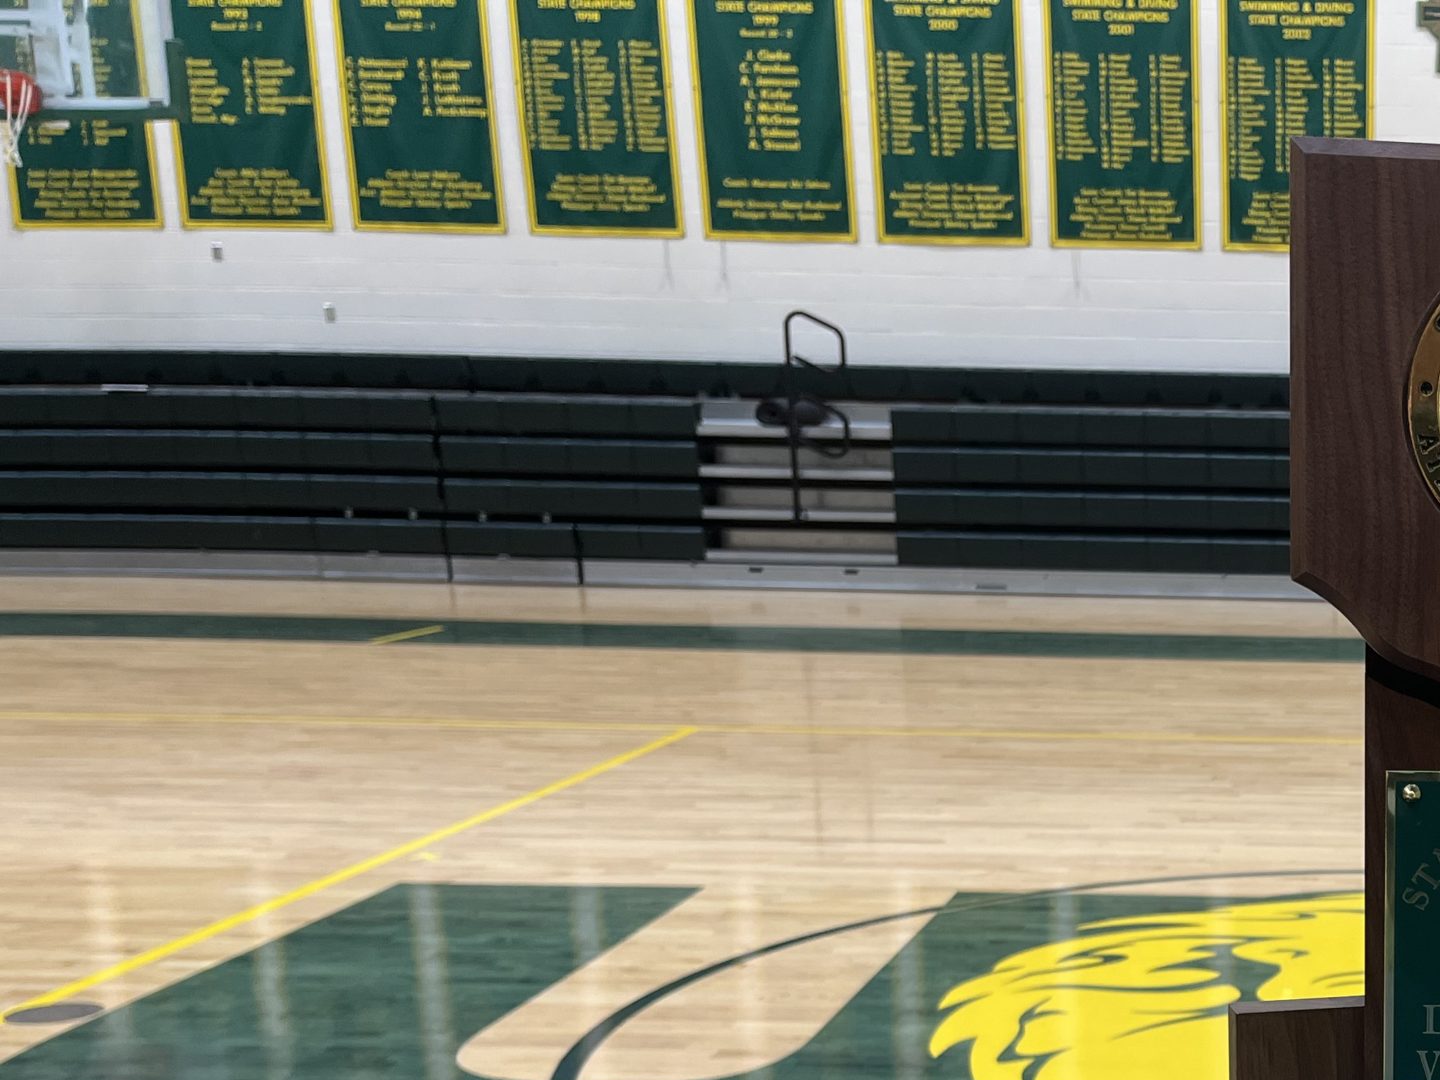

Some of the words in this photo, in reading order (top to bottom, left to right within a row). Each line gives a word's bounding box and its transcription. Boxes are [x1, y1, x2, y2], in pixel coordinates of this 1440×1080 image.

[715, 2, 745, 14] STATE
[747, 2, 814, 14] CHAMPIONS
[893, 5, 923, 17] STATE
[925, 6, 992, 19] CHAMPIONS
[1071, 9, 1100, 21] STATE
[1102, 10, 1169, 23] CHAMPIONS
[1248, 14, 1277, 26] STATE
[1279, 14, 1345, 27] CHAMPIONS
